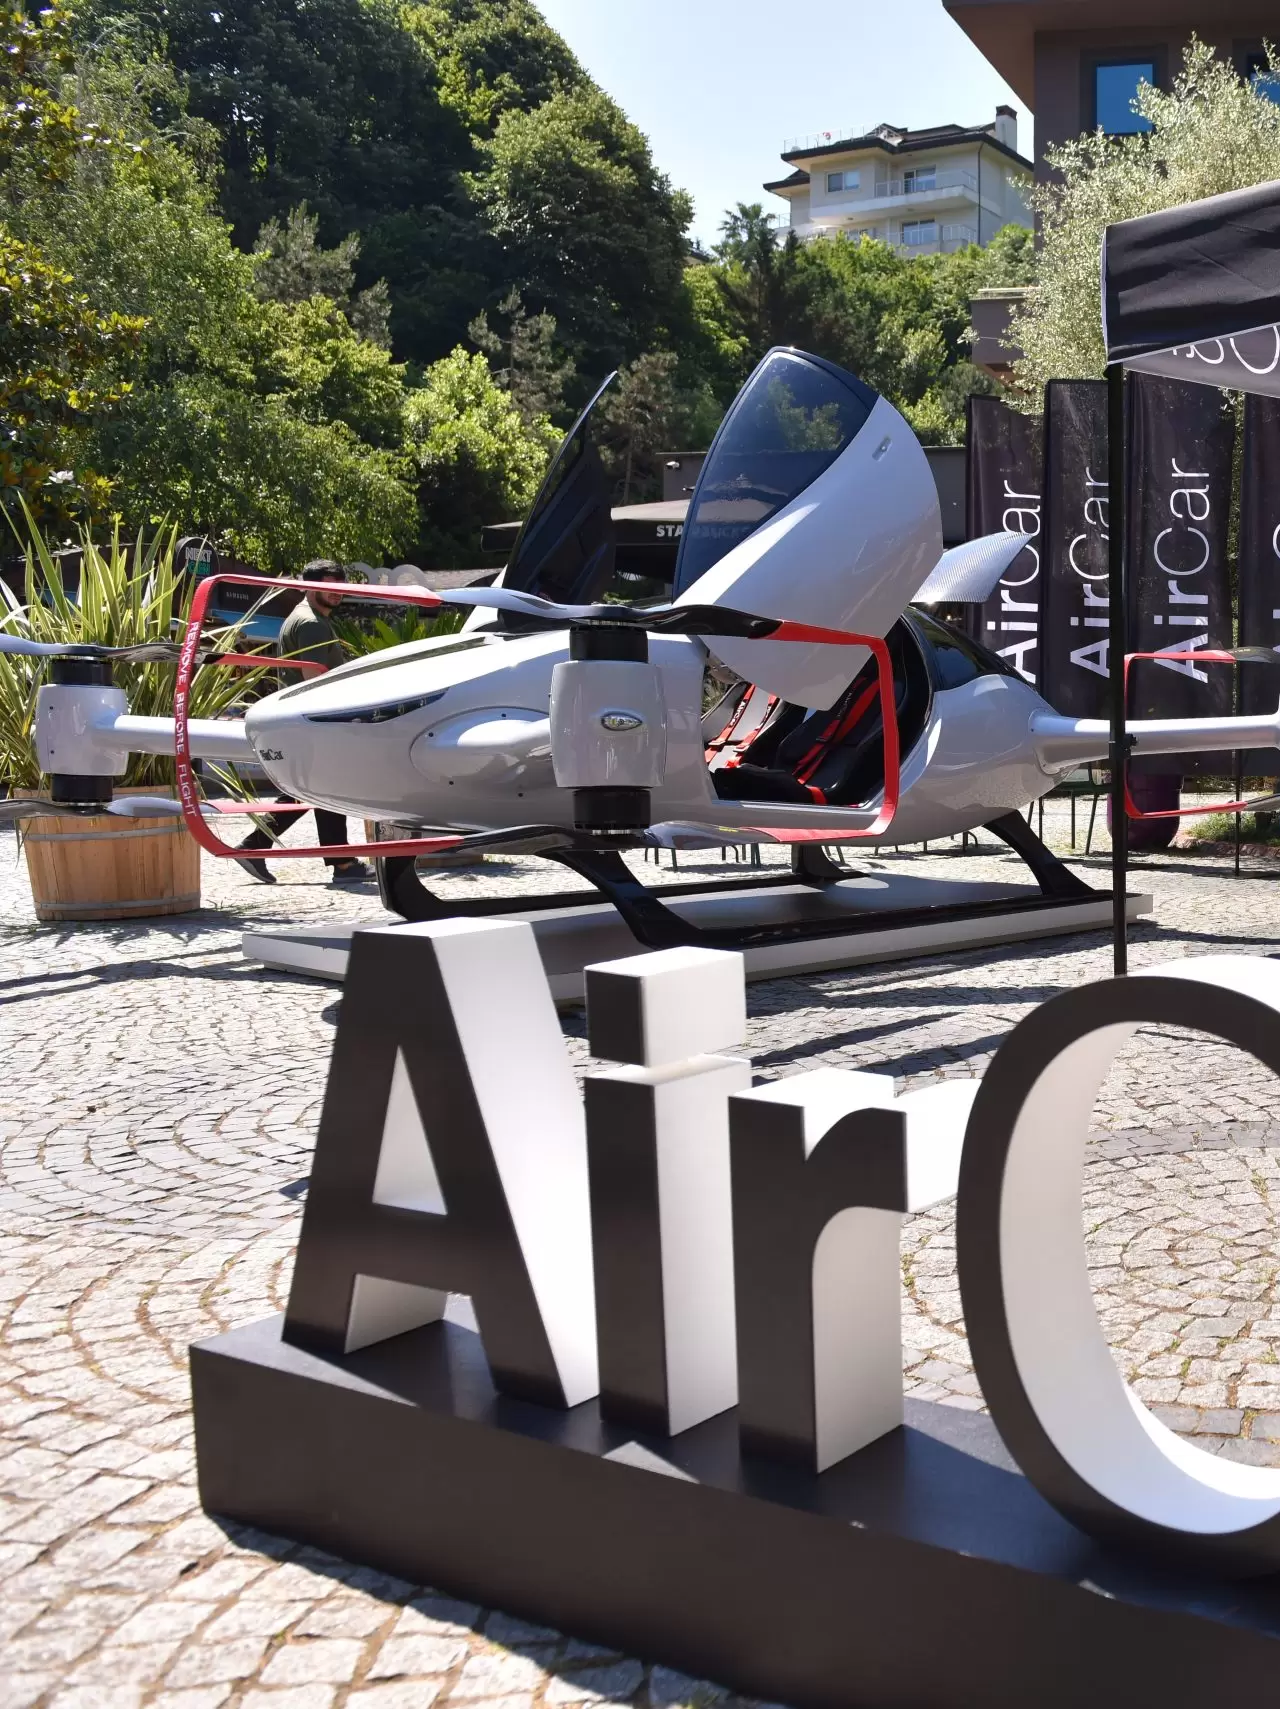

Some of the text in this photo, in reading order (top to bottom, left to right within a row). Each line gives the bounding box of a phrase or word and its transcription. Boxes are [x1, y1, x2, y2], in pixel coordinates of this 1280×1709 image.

[1068, 466, 1111, 679] AirCar
[1153, 457, 1210, 684] AirCar
[175, 621, 199, 817] REMOVE BEFORE FLIGHT
